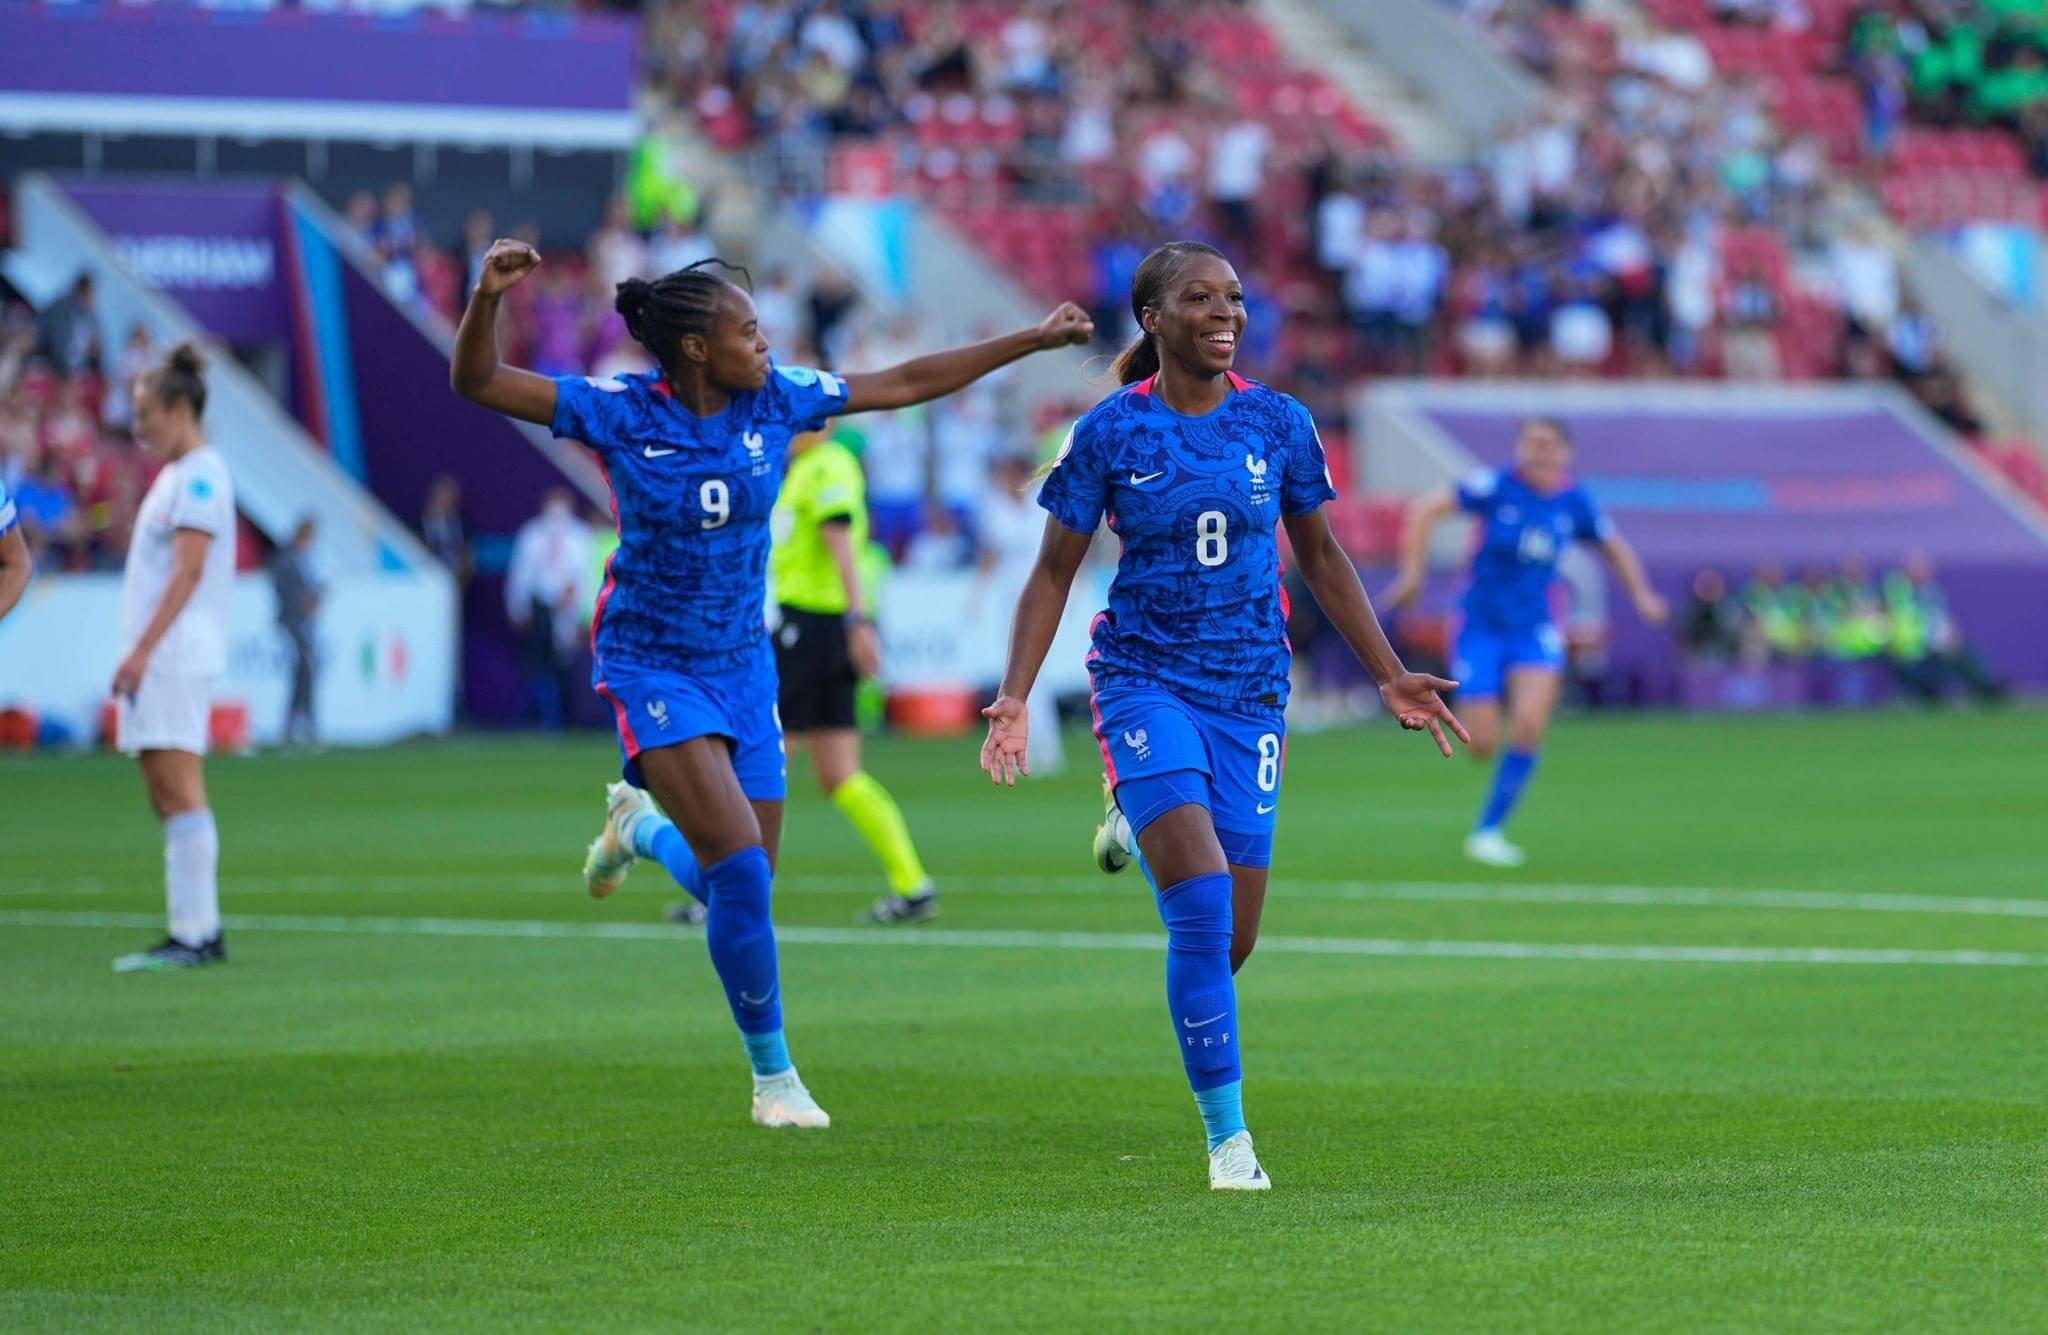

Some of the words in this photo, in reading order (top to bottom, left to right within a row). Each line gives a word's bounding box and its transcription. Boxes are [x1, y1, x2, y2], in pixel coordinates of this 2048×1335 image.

[700, 479, 729, 530] 9
[1196, 510, 1228, 567] 8
[1257, 733, 1280, 792] 8
